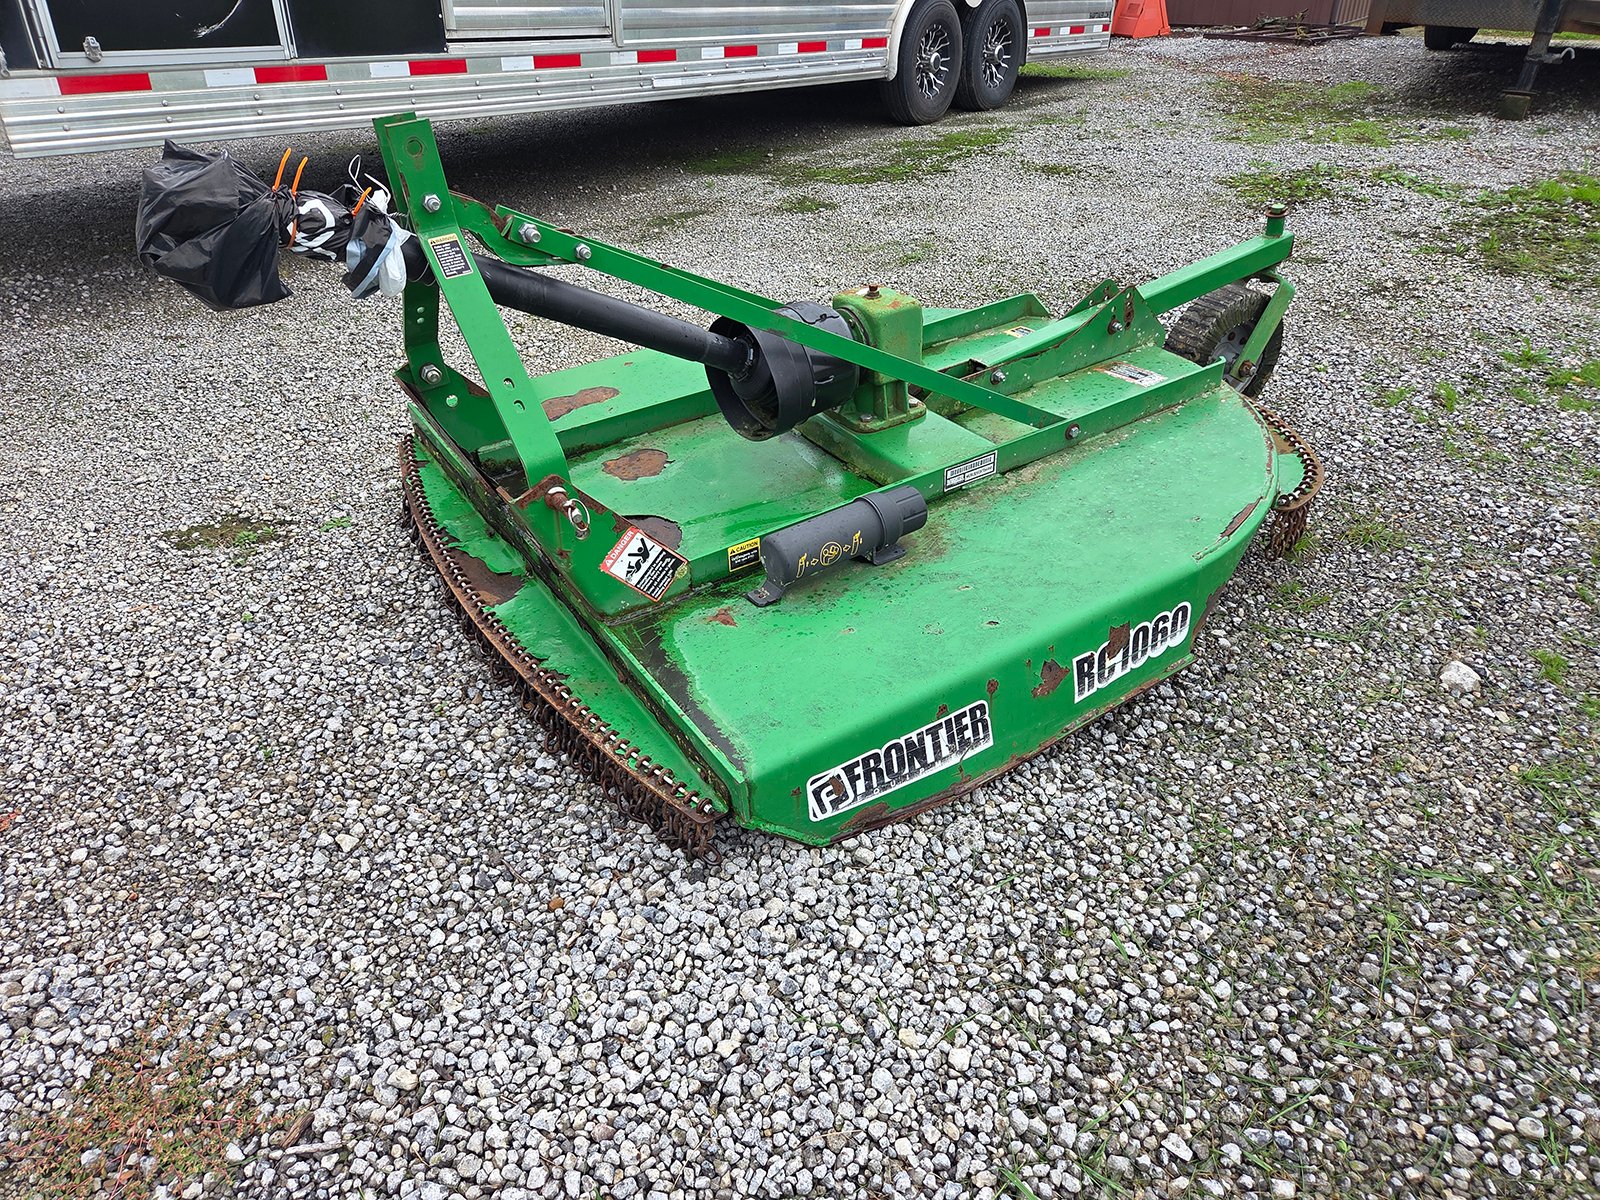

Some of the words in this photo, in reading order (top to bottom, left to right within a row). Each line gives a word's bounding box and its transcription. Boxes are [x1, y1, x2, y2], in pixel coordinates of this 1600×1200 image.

[610, 530, 634, 560] DANGER
[735, 541, 758, 553] CAUTION
[1076, 605, 1189, 698] RC1060
[841, 703, 990, 799] FRONTIER
